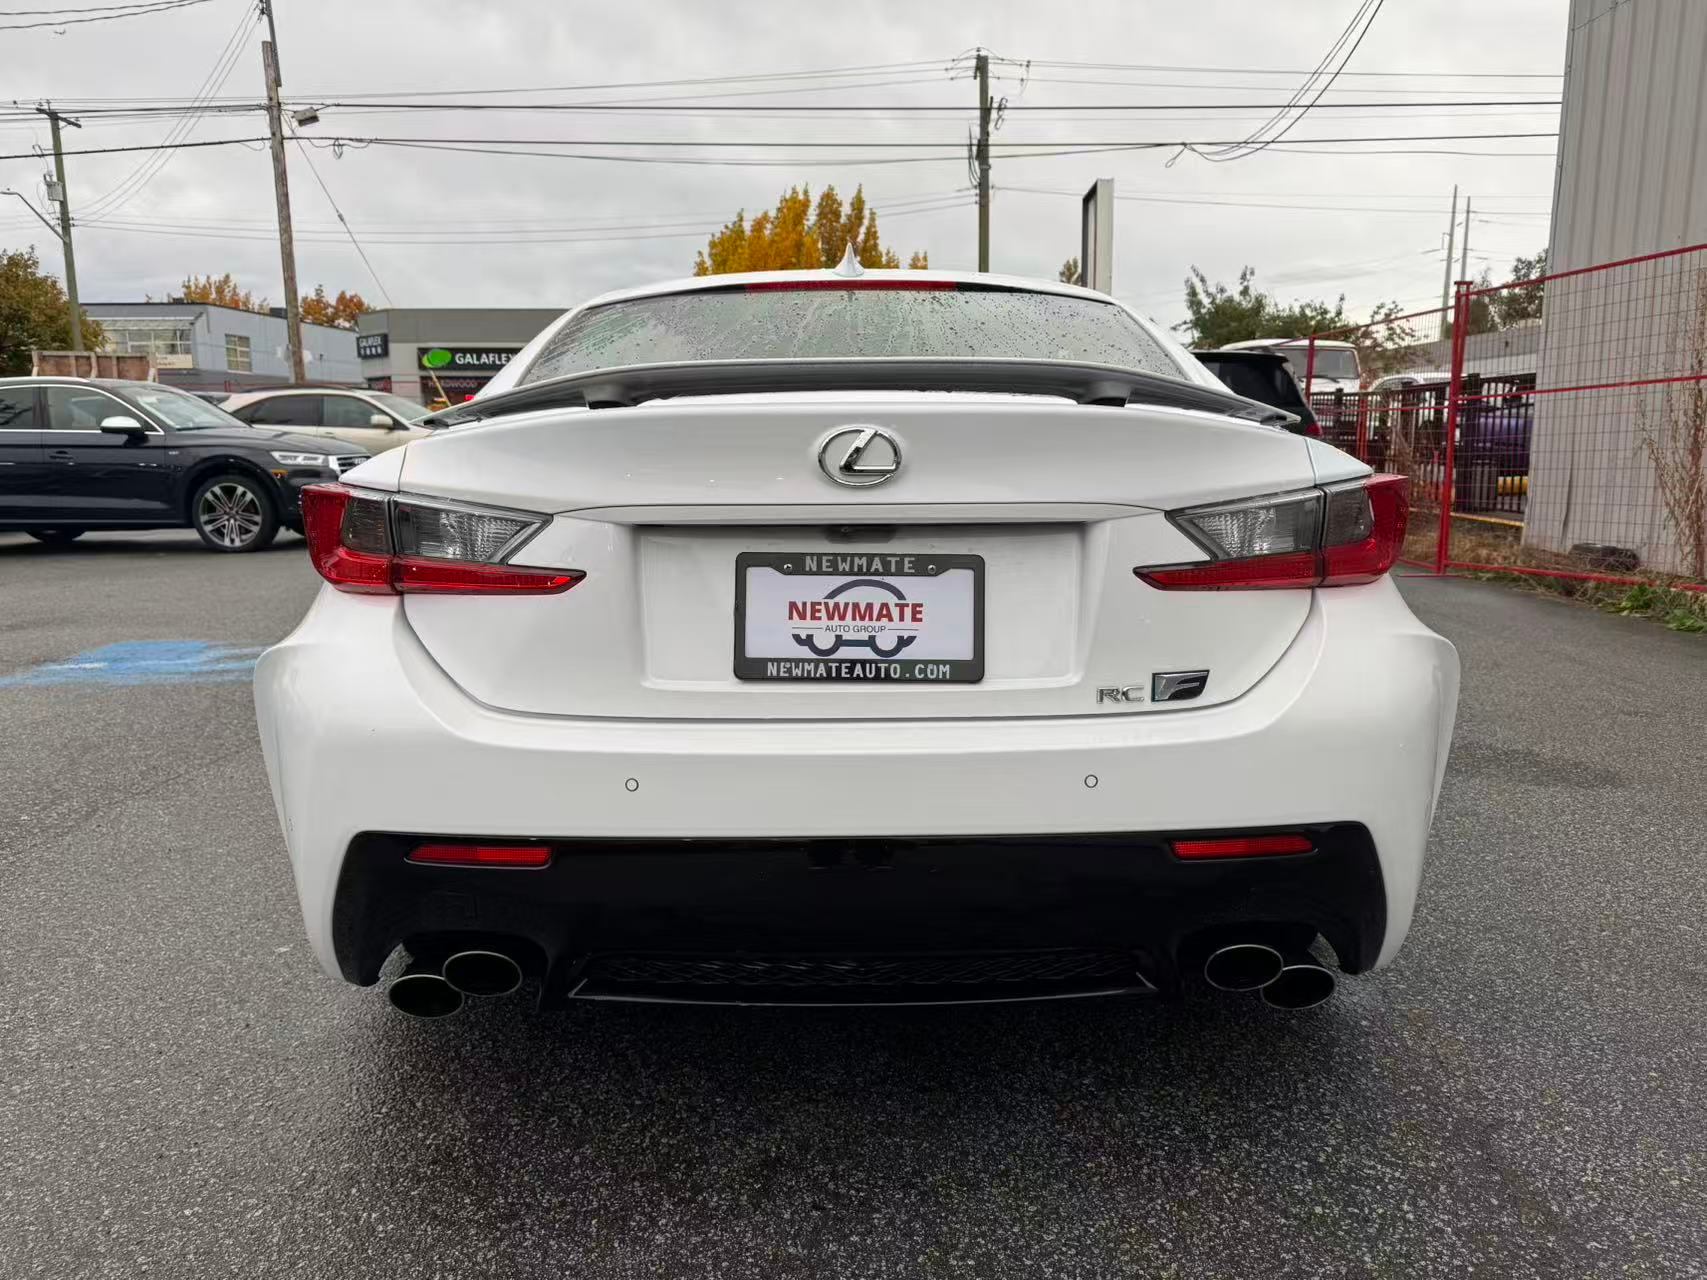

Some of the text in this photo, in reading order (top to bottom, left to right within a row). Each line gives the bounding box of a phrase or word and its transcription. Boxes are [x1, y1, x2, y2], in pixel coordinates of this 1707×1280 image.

[804, 555, 916, 573] NEWMATE
[788, 601, 924, 623] NEWMATE
[824, 624, 887, 634] AUTO GROUP
[767, 661, 951, 680] NEWMATEAUTO.COM
[1096, 685, 1145, 704] RC
